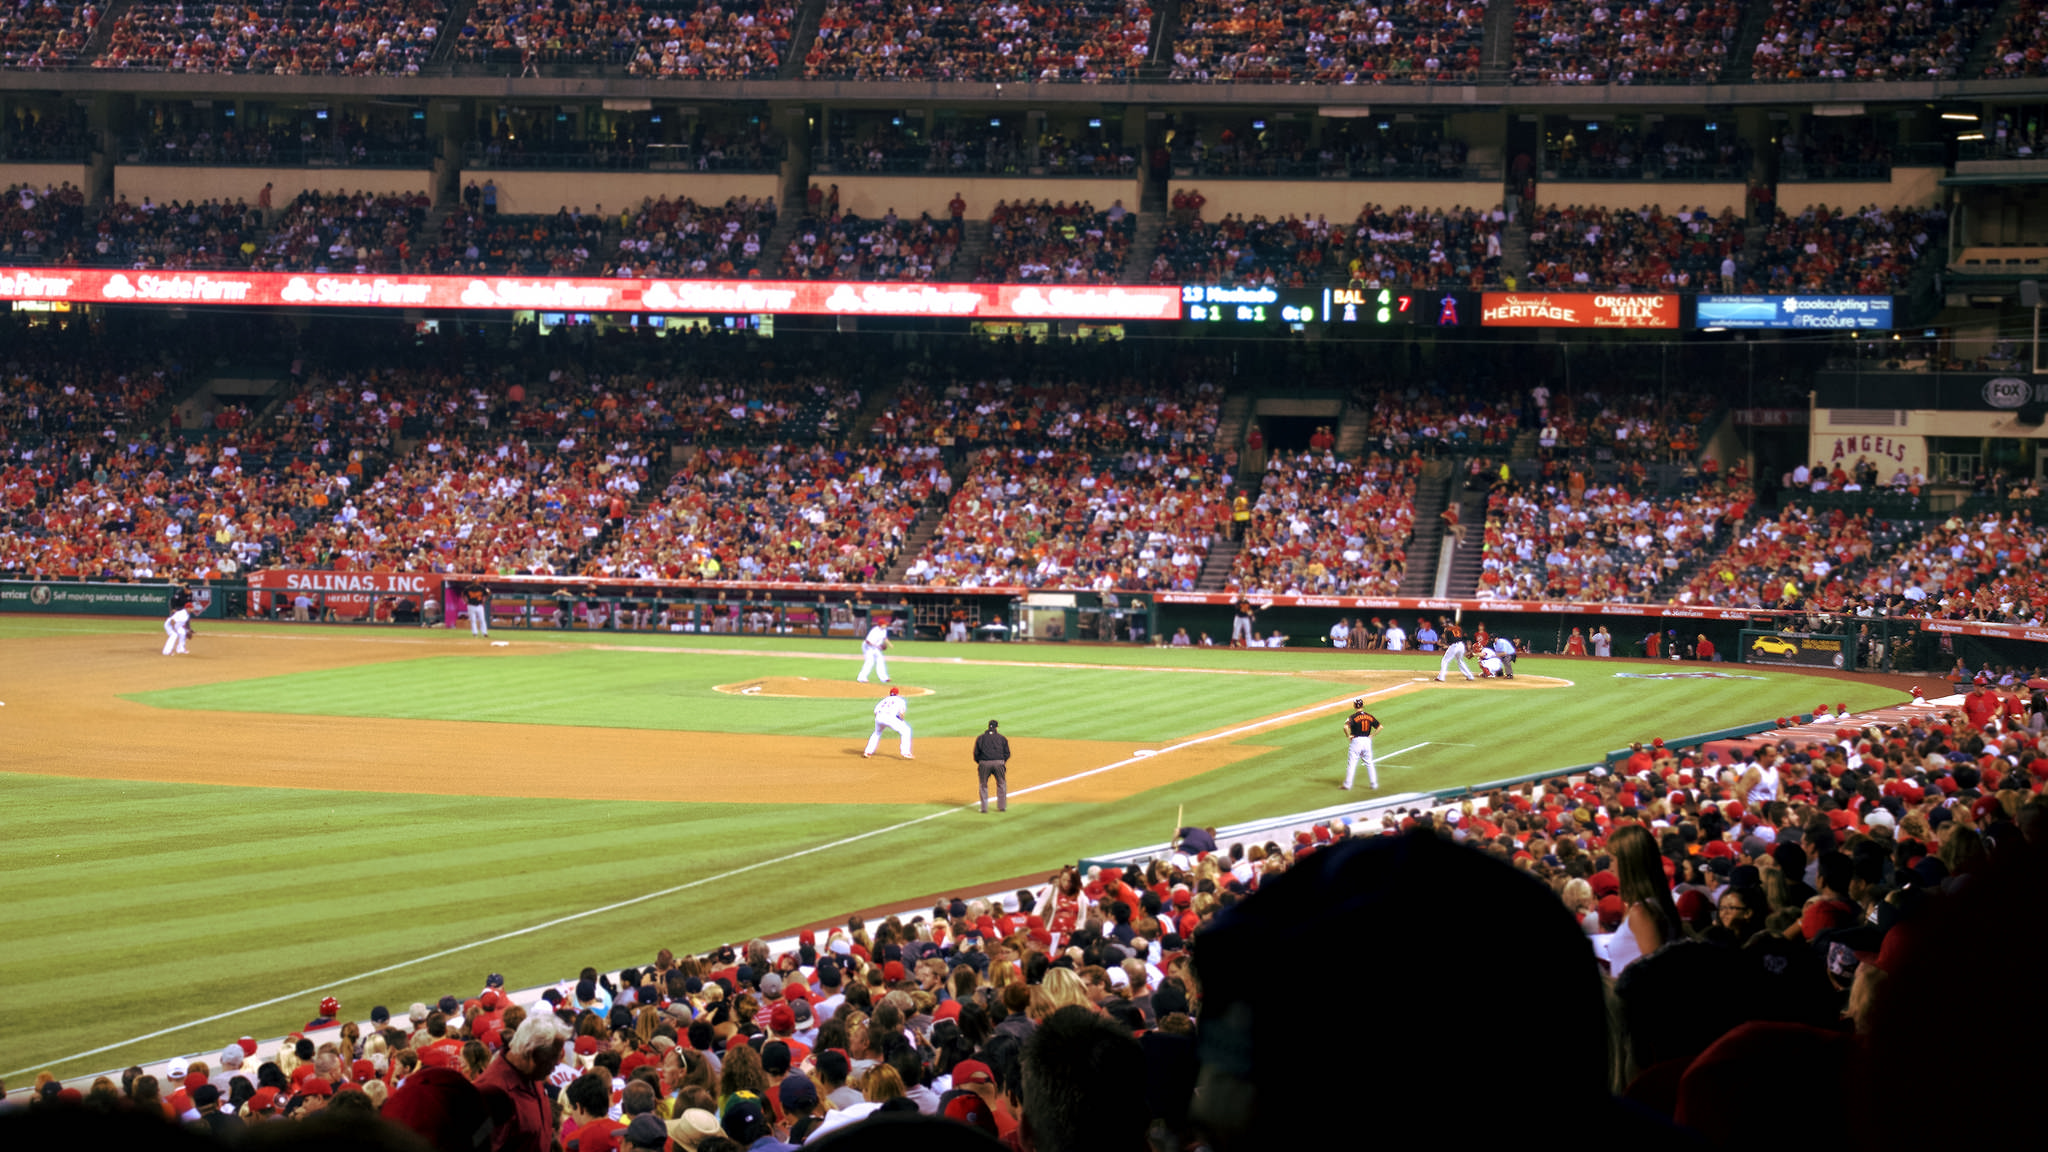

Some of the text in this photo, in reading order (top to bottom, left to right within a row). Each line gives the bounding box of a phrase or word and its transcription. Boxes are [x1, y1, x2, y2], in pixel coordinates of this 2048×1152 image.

[1333, 289, 1365, 305] BAL
[1376, 288, 1390, 305] 4
[1398, 296, 1411, 312] 7
[1594, 295, 1664, 308] ORGANIC
[1610, 306, 1653, 318] MILK
[1799, 298, 1868, 312] coolsculpting
[1376, 306, 1391, 323] 6
[1483, 305, 1575, 323] HERITAGE
[1802, 314, 1855, 327] PicoSure
[1994, 383, 2020, 397] FOX
[1831, 435, 1906, 462] ANGELS
[387, 576, 430, 592] INC.
[68, 592, 94, 602] moving
